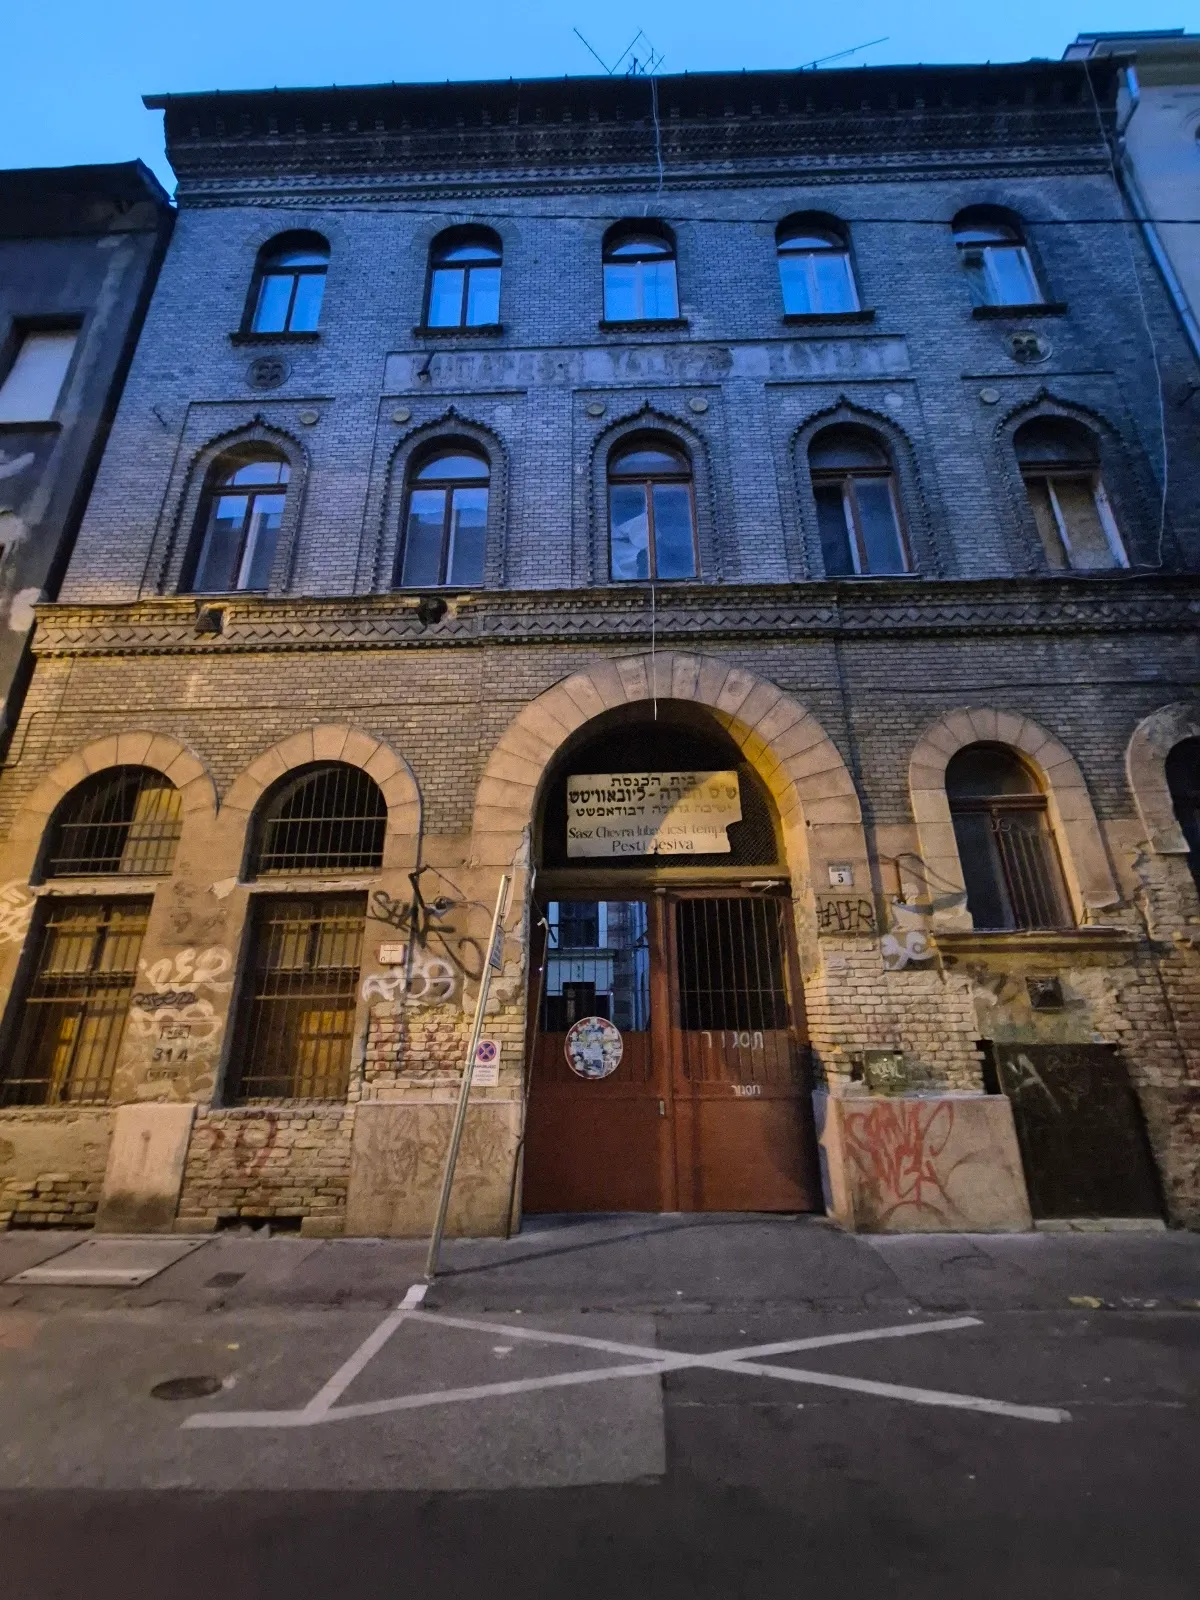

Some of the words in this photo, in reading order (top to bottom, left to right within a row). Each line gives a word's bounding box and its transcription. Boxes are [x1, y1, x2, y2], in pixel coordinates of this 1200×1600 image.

[610, 777, 661, 787] הכנסת
[670, 776, 697, 786] בית
[576, 806, 645, 817] דבודאפשט
[568, 827, 593, 839] Sasz
[612, 840, 646, 852] Pesti
[651, 838, 694, 850] Jesiva
[838, 873, 844, 883] 5
